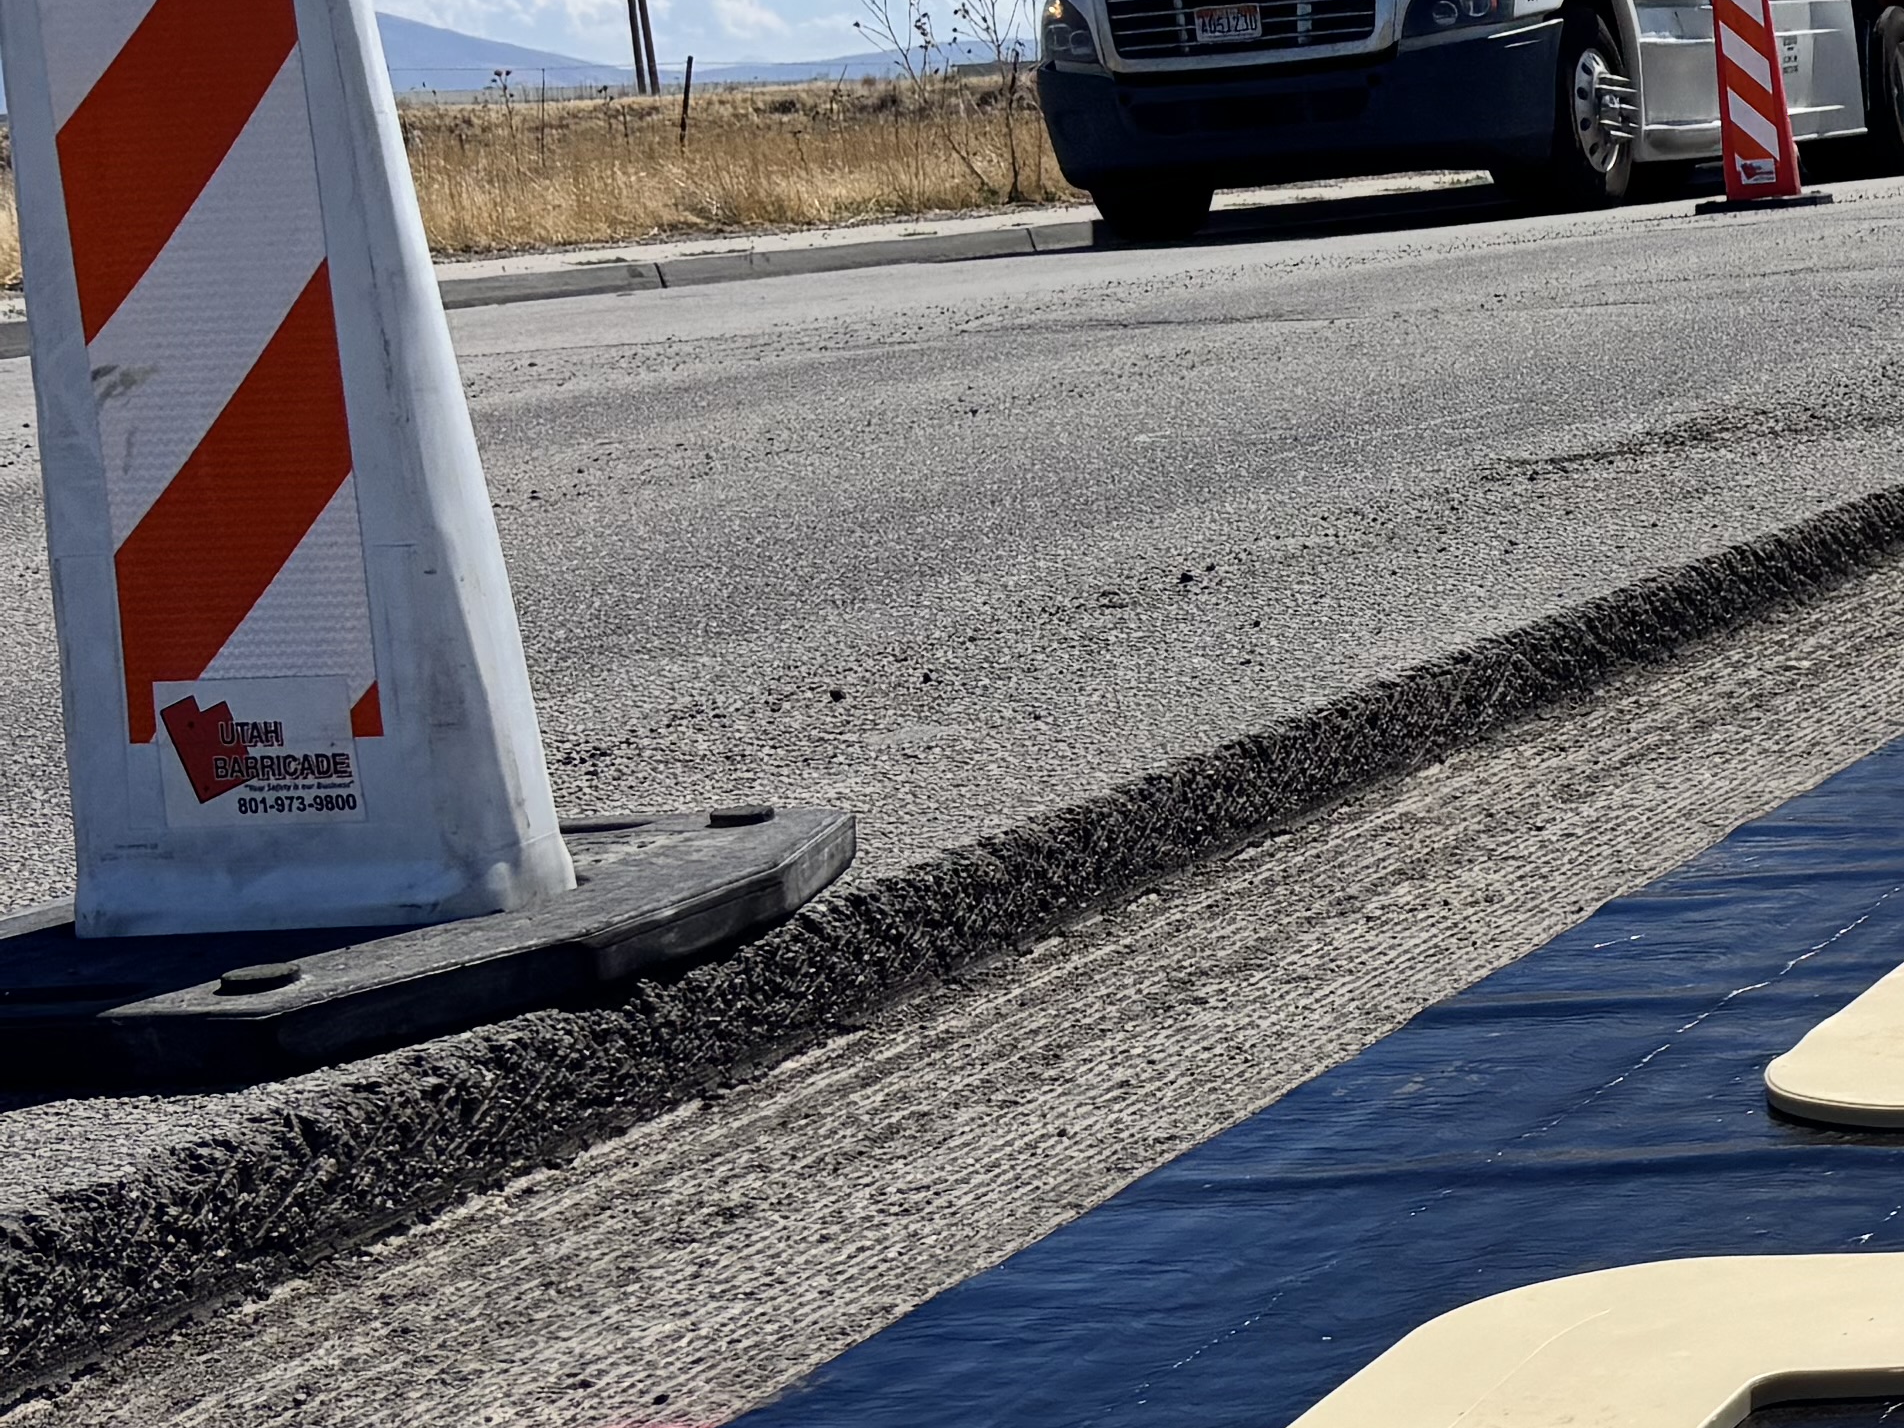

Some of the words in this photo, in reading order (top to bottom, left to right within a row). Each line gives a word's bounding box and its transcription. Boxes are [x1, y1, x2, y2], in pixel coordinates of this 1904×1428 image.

[219, 721, 284, 747] UTAH
[213, 752, 353, 781] BARRICADE
[237, 793, 357, 814] 801-973-9800
